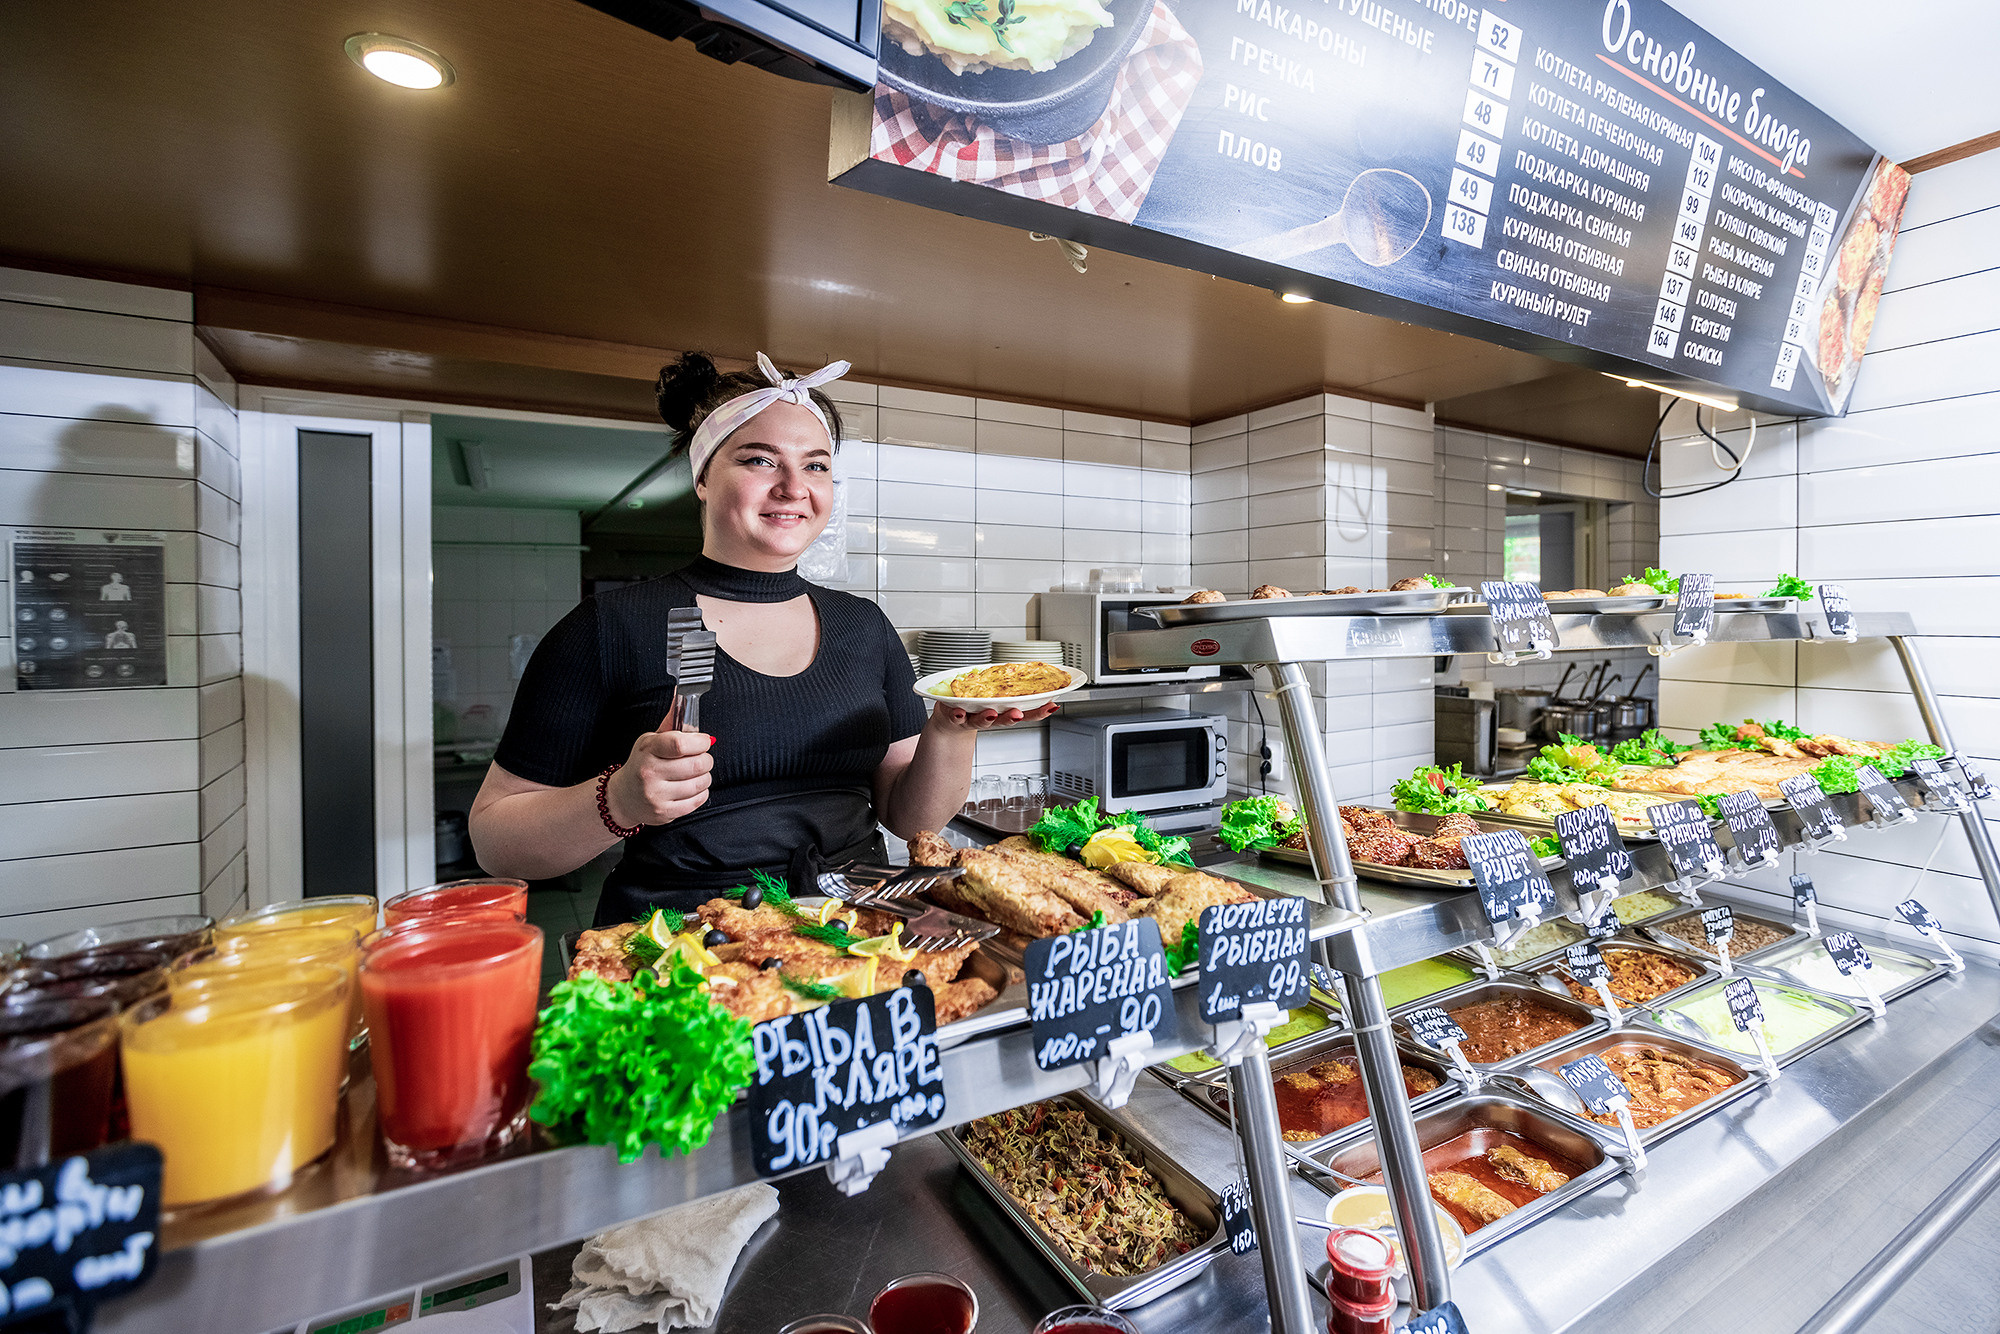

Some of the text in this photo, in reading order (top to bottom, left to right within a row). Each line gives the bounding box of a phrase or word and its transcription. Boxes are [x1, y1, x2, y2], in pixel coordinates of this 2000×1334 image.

[1236, 0, 1492, 125] МАКАРОНЫ 48
[1490, 24, 1509, 50] 52
[1230, 36, 1485, 164] ГРЕЧКА 49
[1483, 62, 1499, 87] 71
[1535, 46, 1716, 165] КОТЛЕТА РУБЛЕНАЯ КУРИНАЯ 104
[1602, 0, 1811, 174] Основные блюда
[1224, 83, 1478, 201] РИС 49
[1521, 116, 1699, 214] КОТЛЕТА ДОМАШНЯЯ 99
[1529, 82, 1709, 188] КОТЛЕТА ПЕЧЕНОЧНАЯ 112
[1218, 130, 1475, 236] ПЛОВ 138
[1515, 150, 1697, 241] ПОДЖАРКА КУРИНАЯ 149
[1721, 183, 1769, 219] ОКОРОЧОК
[1766, 207, 1807, 239] ЖАРЕНЫЙ
[1727, 155, 1753, 182] МЯСО
[1752, 169, 1817, 217] ПО-ФРАНЦУЗСКИ
[1502, 216, 1683, 297] КУРИНАЯ ОТБИВНАЯ 137
[1508, 183, 1690, 270] ПОДЖАРКА СВИНАЯ 154
[1708, 236, 1735, 261] РЫБА
[1734, 247, 1775, 278] ЖАРЕНАЯ
[1714, 209, 1747, 238] ГУЛЯШ
[1746, 224, 1788, 257] ГОВЯЖИЙ
[1497, 249, 1676, 323] СВИНАЯ ОТБИВНАЯ 146
[1695, 289, 1737, 320] ГОЛУБЕЦ
[1702, 263, 1728, 288] РЫБА
[1728, 275, 1736, 290] В
[1735, 278, 1764, 300] КЛЯРЕ
[1490, 281, 1669, 349] КУРИНЫЙ РУЛЕТ 164
[1690, 315, 1731, 342] ТЕФТЕЛЯ
[1683, 341, 1723, 366] СОСИСКА
[1481, 852, 1531, 887] РУЛЕТ
[1044, 919, 1139, 978] РЫБА
[1206, 927, 1306, 972] РЫБНАЯ
[1826, 932, 1858, 952] ПЮРЕ
[1030, 952, 1165, 1021] ЖАРЕНАЯ
[1120, 993, 1162, 1037] 90
[752, 987, 921, 1085] РЫБА В
[811, 1032, 943, 1115] КЛЯРЕ
[1560, 1057, 1613, 1089] ГОЛУБЕЦ
